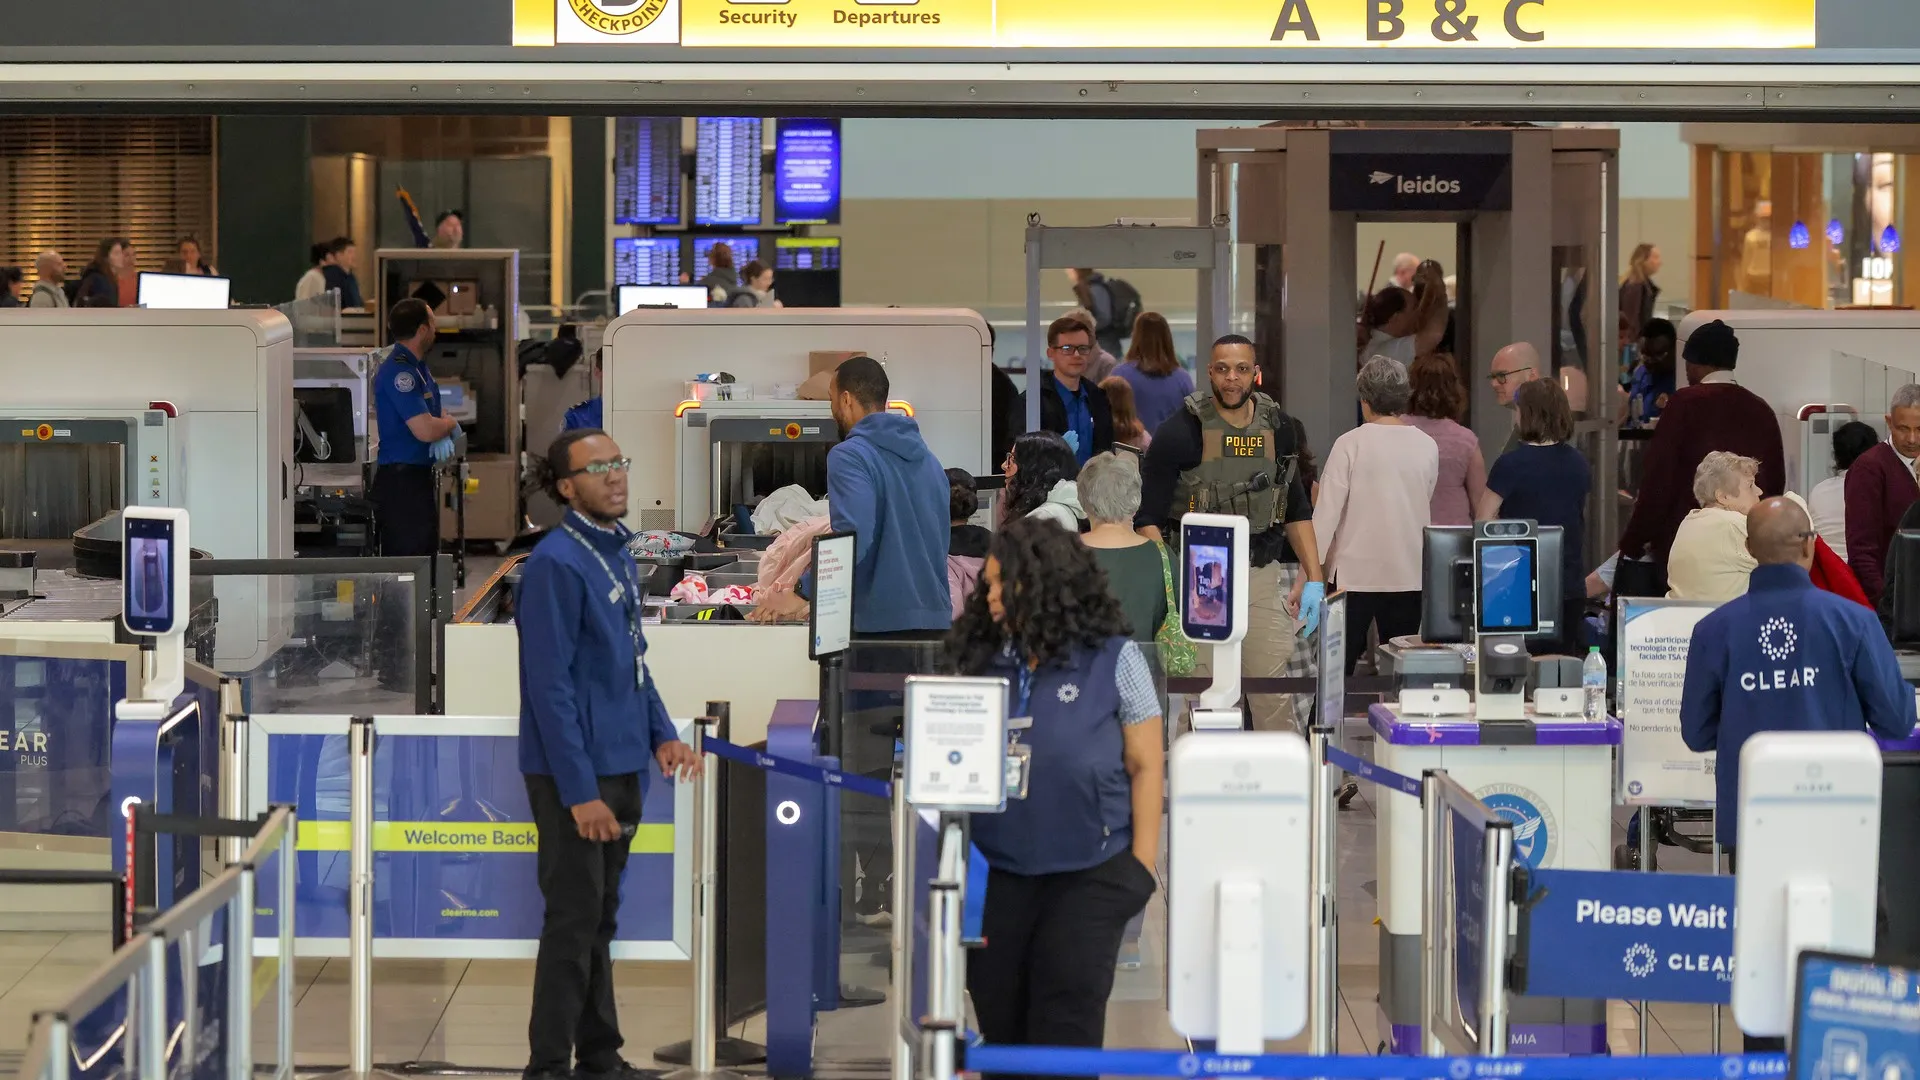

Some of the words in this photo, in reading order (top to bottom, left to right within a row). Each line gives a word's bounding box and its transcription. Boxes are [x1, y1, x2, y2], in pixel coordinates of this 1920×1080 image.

[573, 0, 664, 31] CHECKPOIN
[719, 9, 798, 28] Security
[833, 9, 941, 28] Departures
[1270, 0, 1320, 41] A
[1366, 0, 1406, 41] B
[1430, 0, 1479, 42] &
[1503, 0, 1545, 42] C
[1397, 175, 1461, 194] leidos
[1226, 436, 1263, 447] POLICE
[1234, 447, 1254, 456] ICE
[1654, 636, 1689, 645] participac
[1668, 645, 1678, 653] de
[1669, 653, 1682, 661] TSA
[1647, 680, 1684, 689] verificació
[1740, 667, 1816, 692] CLEAR
[1662, 698, 1682, 706] oficia
[1665, 707, 1680, 715] tom
[0, 729, 48, 753] EAR
[20, 754, 48, 767] PLUS
[404, 829, 488, 845] Welcome
[492, 830, 536, 846] Back
[440, 906, 499, 918] clearme.com
[1576, 899, 1662, 927] Please
[1667, 903, 1729, 930] Wait
[1748, 1059, 1791, 1075] CLEA
